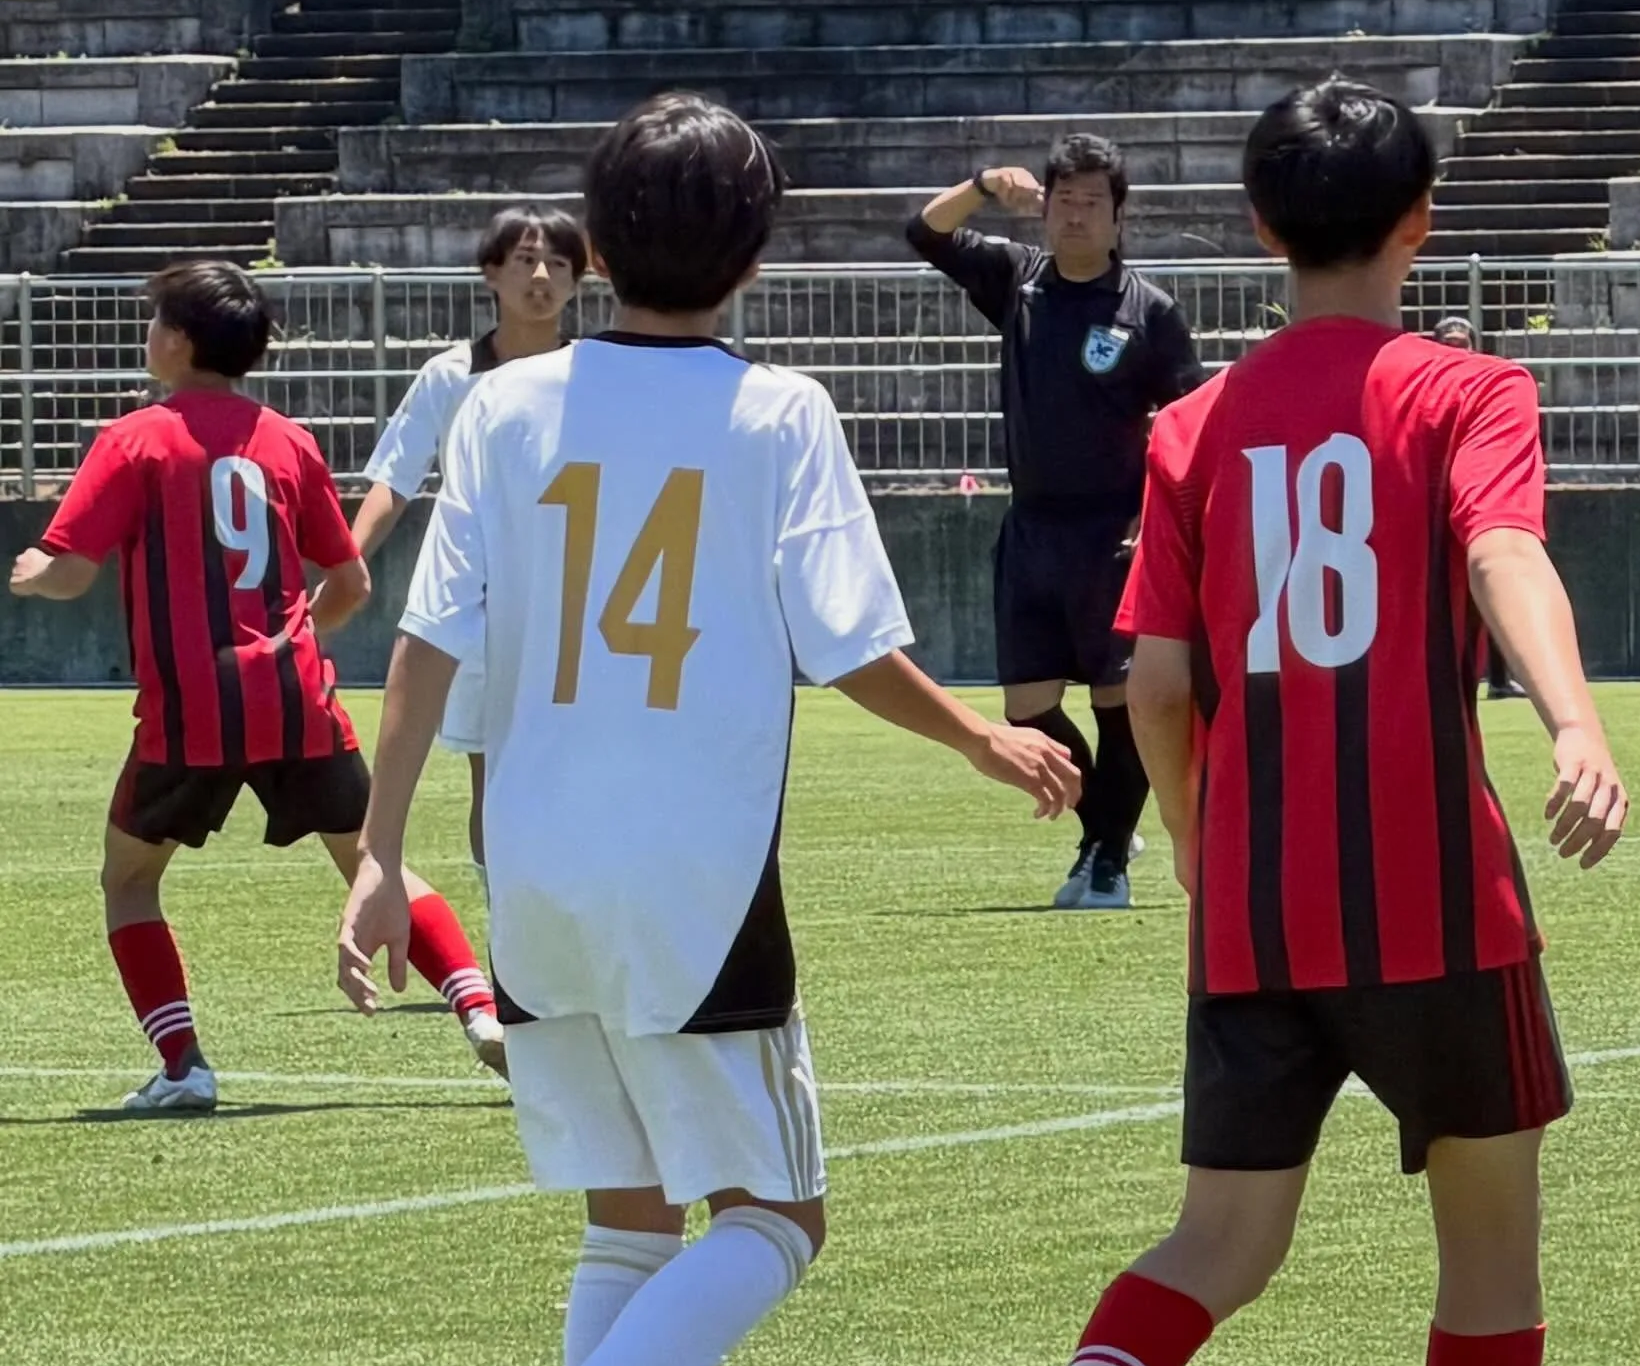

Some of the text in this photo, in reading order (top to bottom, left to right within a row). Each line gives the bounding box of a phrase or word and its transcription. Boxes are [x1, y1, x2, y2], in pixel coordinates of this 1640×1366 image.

[211, 455, 271, 590] 9
[538, 462, 704, 711] 14
[1241, 432, 1379, 674] 18
